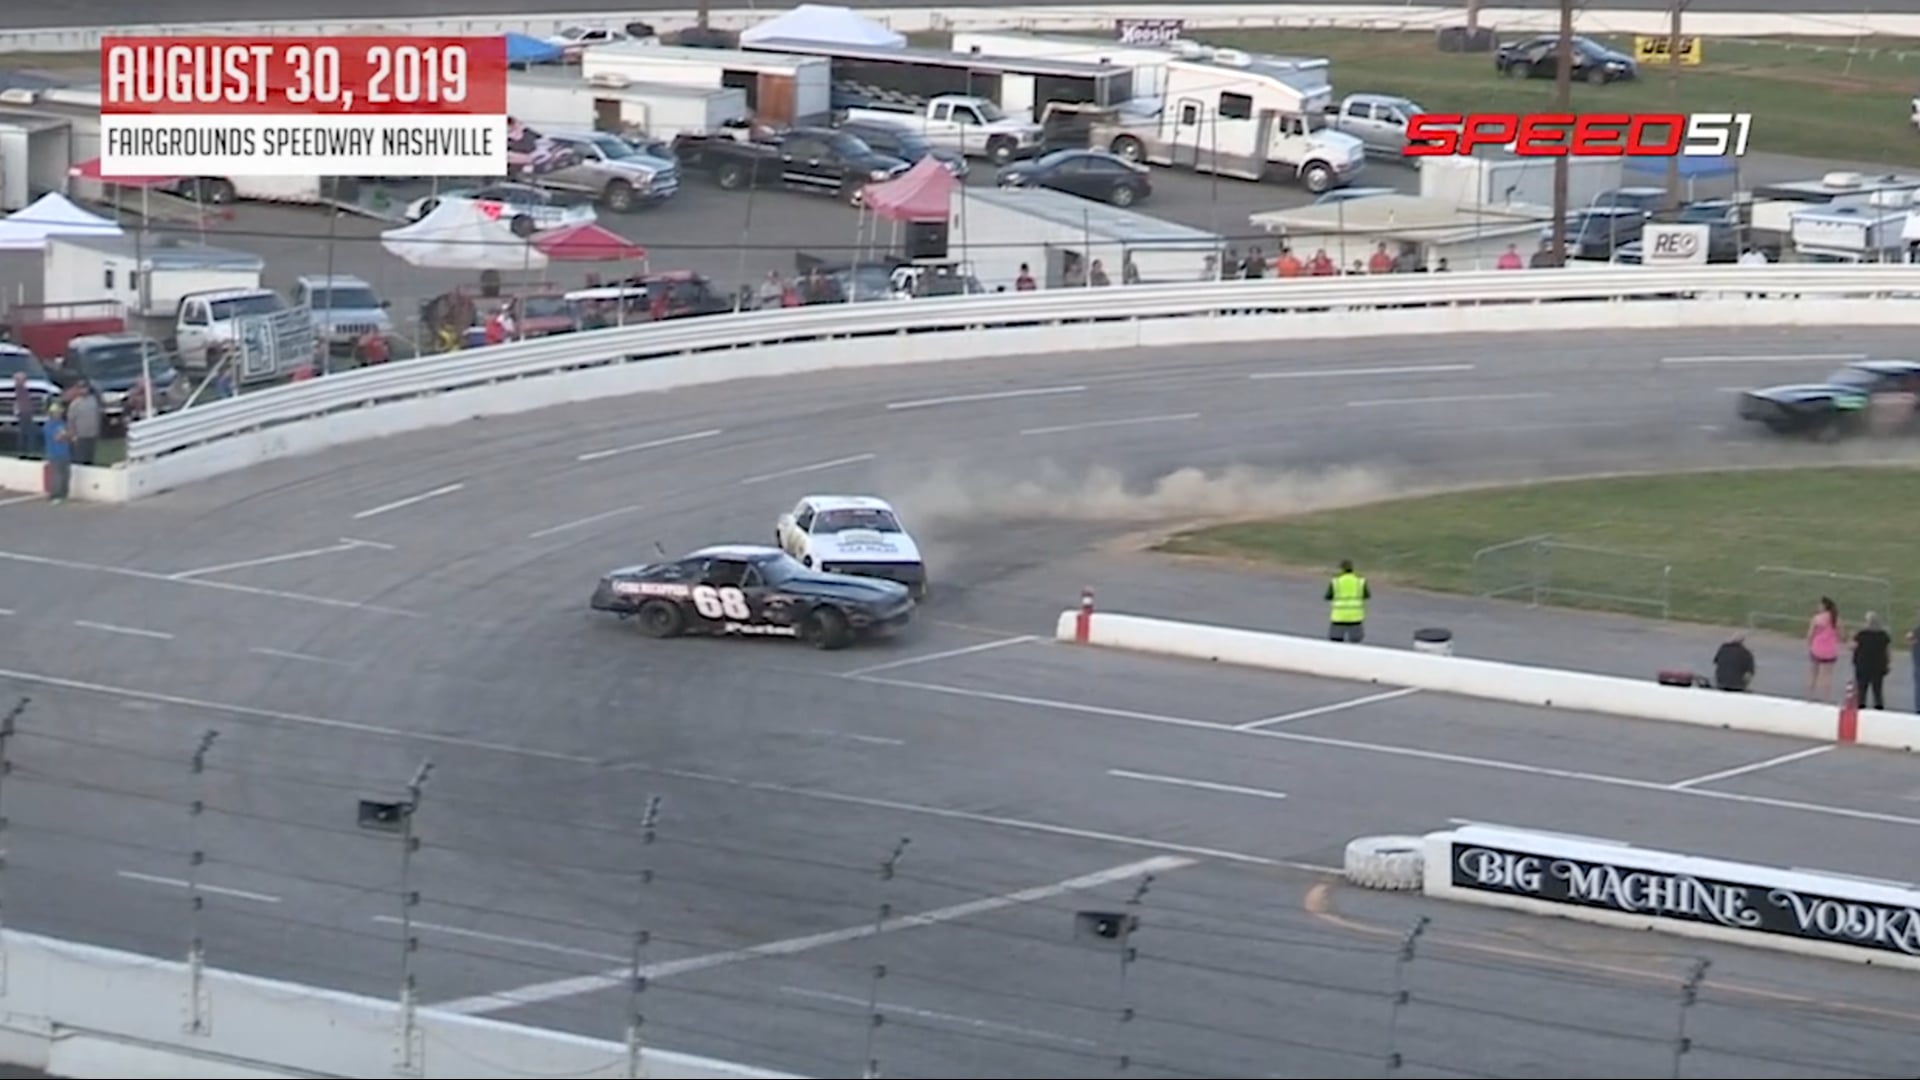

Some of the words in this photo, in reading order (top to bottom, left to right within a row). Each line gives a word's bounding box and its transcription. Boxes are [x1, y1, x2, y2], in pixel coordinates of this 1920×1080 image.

[692, 585, 750, 620] 68
[1459, 847, 1543, 892] BIG
[1550, 860, 1762, 928] MACHINE
